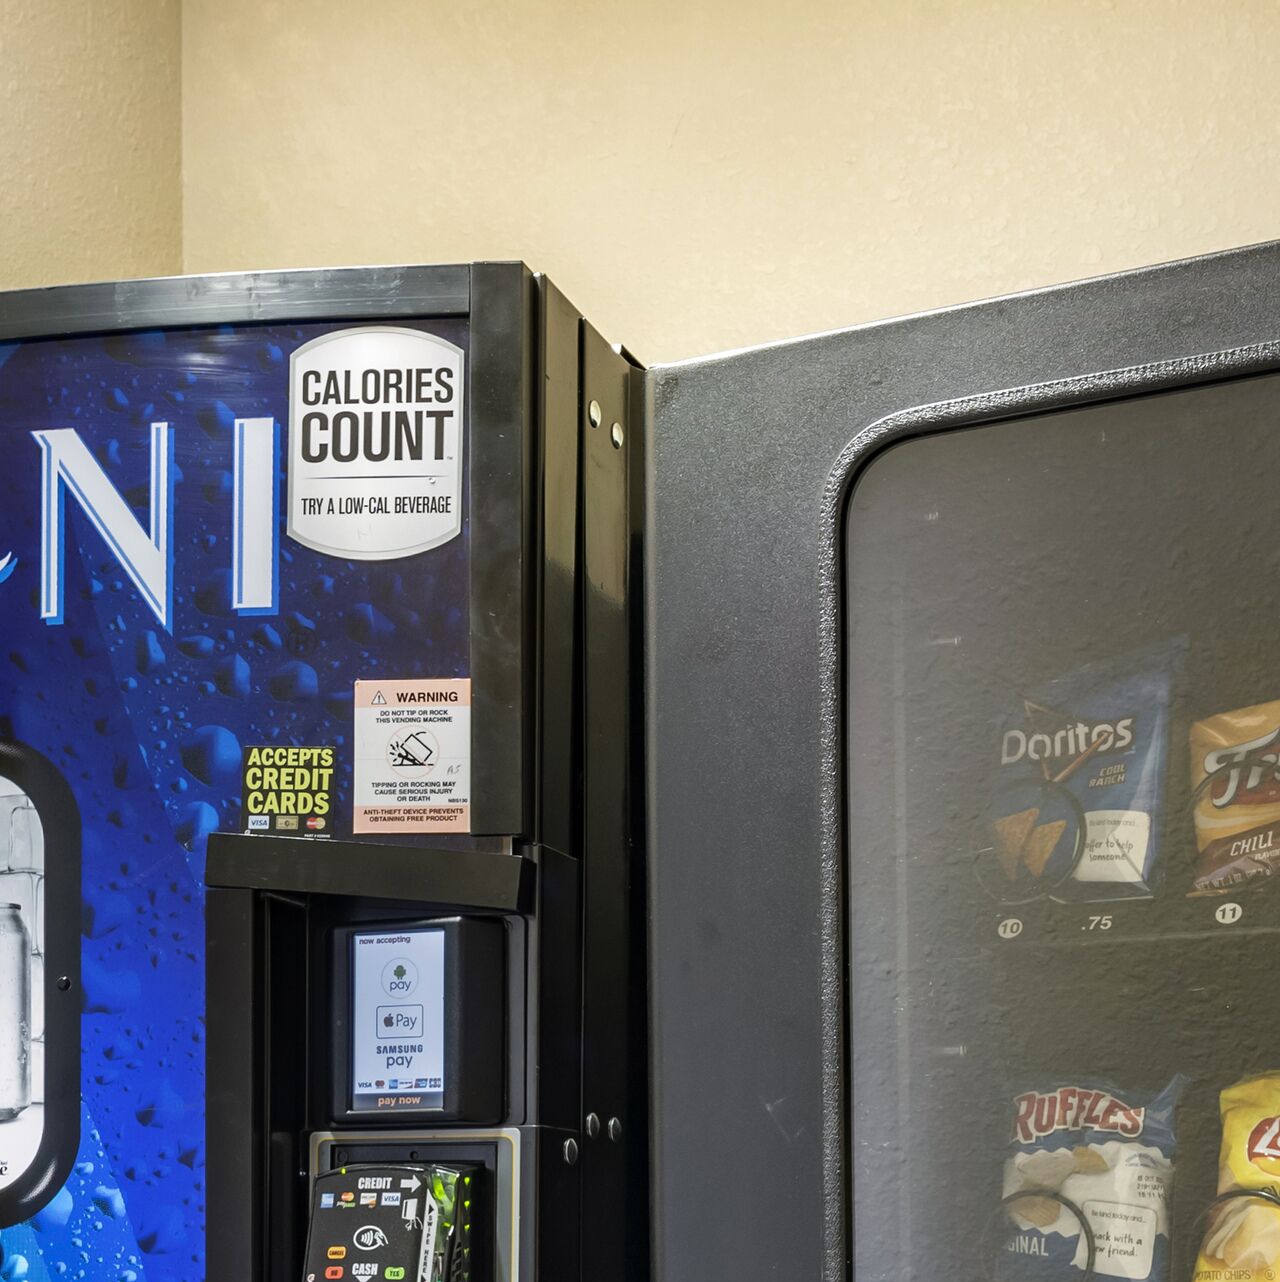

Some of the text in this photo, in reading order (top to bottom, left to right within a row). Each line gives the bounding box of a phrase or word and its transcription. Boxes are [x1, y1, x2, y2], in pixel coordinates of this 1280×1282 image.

[302, 367, 454, 406] CALORIES
[301, 409, 454, 464] COUNT
[301, 495, 452, 515] TRY A LOW-CAL BEVERAGE
[396, 691, 458, 703] WARNING
[1001, 718, 1135, 766] Doritos
[247, 747, 334, 767] ACCEPTS
[245, 767, 334, 791] CREDIT
[247, 791, 330, 815] CARDS
[363, 808, 402, 816] ANTI-THEFT
[428, 807, 464, 815] PREVENTS
[369, 815, 406, 823] OBTAINING
[1229, 831, 1274, 857] CHILI
[358, 935, 411, 945] now accepting
[389, 980, 412, 992] pay
[395, 1013, 418, 1030] Pay
[376, 1044, 424, 1055] SAMSUNG
[386, 1055, 413, 1069] pay
[377, 1095, 421, 1107] pay now
[1012, 1087, 1145, 1143] RUFFLES
[357, 1177, 393, 1190] CREDIT
[351, 1262, 379, 1276] CASH
